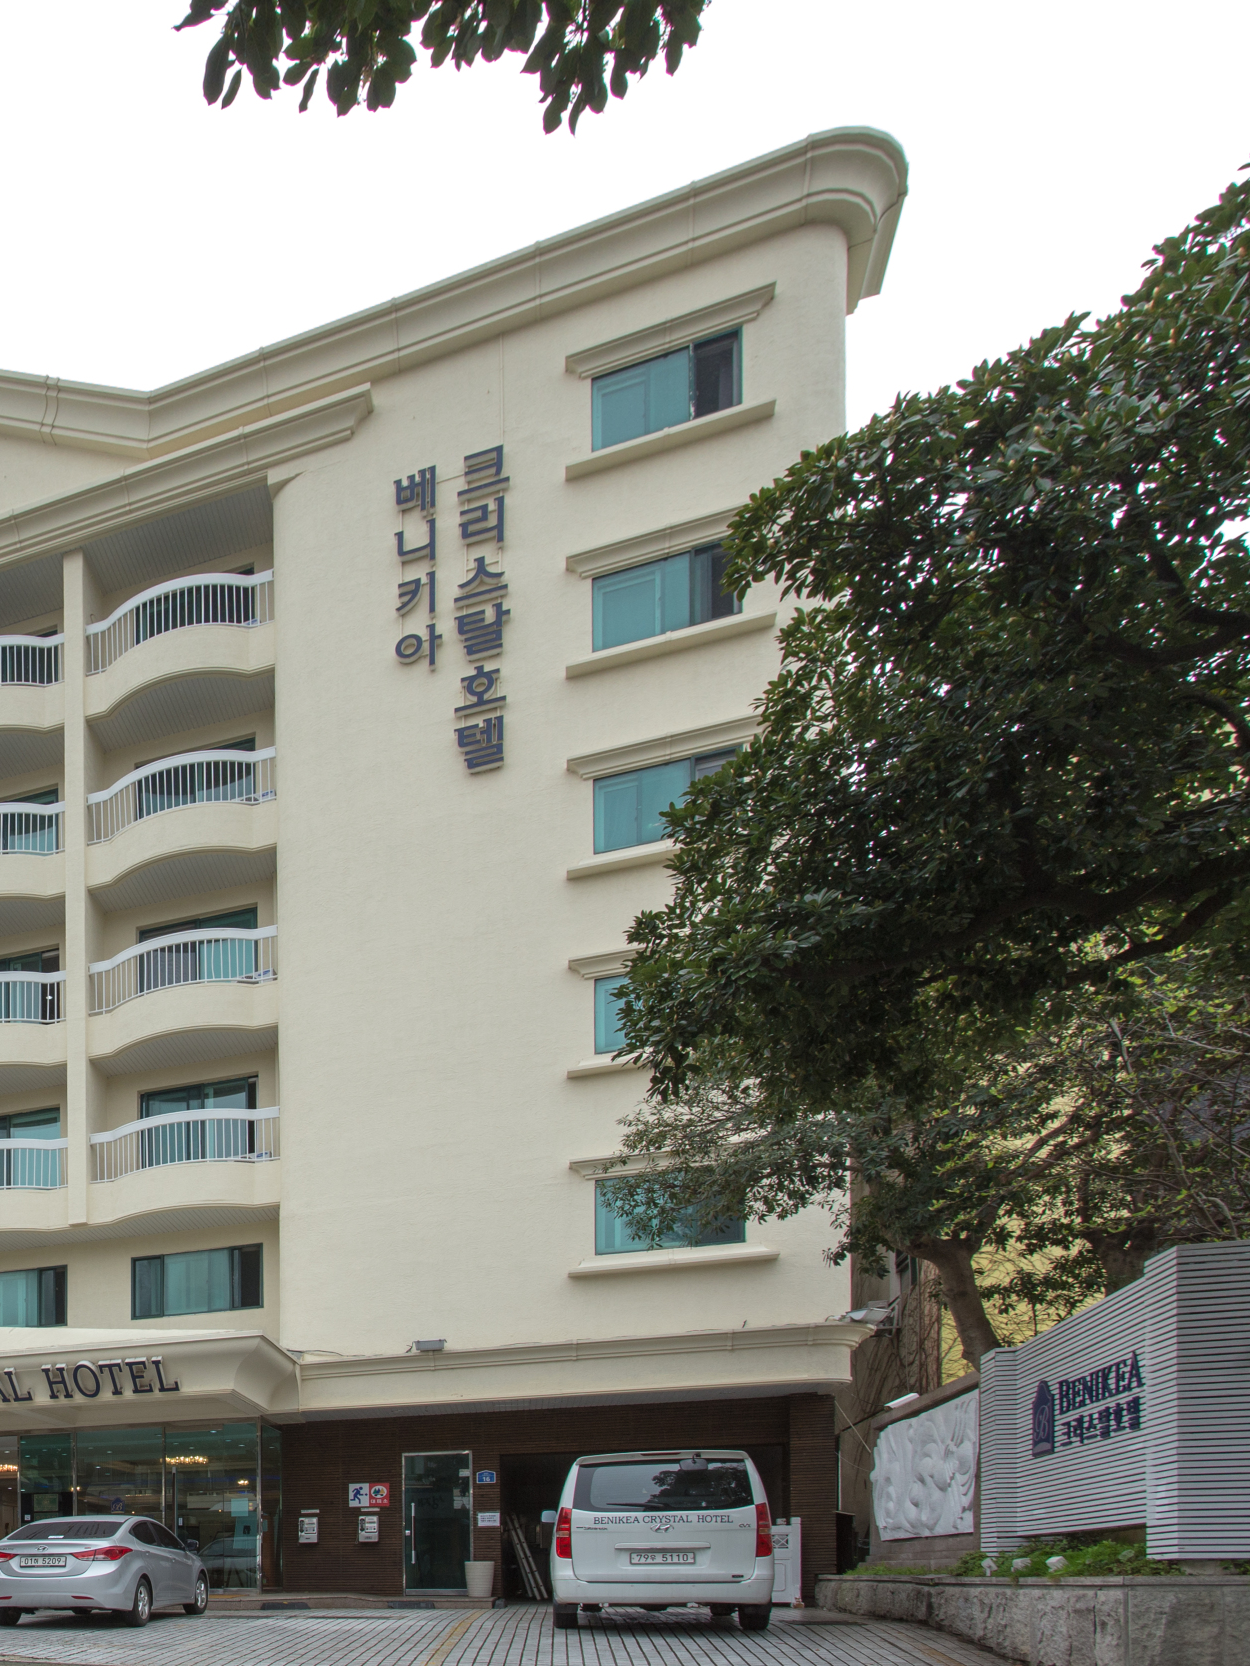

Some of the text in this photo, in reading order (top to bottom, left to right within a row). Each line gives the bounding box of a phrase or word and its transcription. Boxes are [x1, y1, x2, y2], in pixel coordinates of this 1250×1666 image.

[393, 465, 442, 671] 베니키아
[454, 444, 510, 773] 크리스탈호텔
[41, 1356, 181, 1400] HOTEL
[1058, 1351, 1143, 1415] BENIKEA
[1059, 1395, 1141, 1447] 크리스탈호텔
[593, 1514, 734, 1525] BENIKEA CRYSTAL HOTEL
[42, 1556, 62, 1564] 5209
[661, 1553, 689, 1562] 5110
